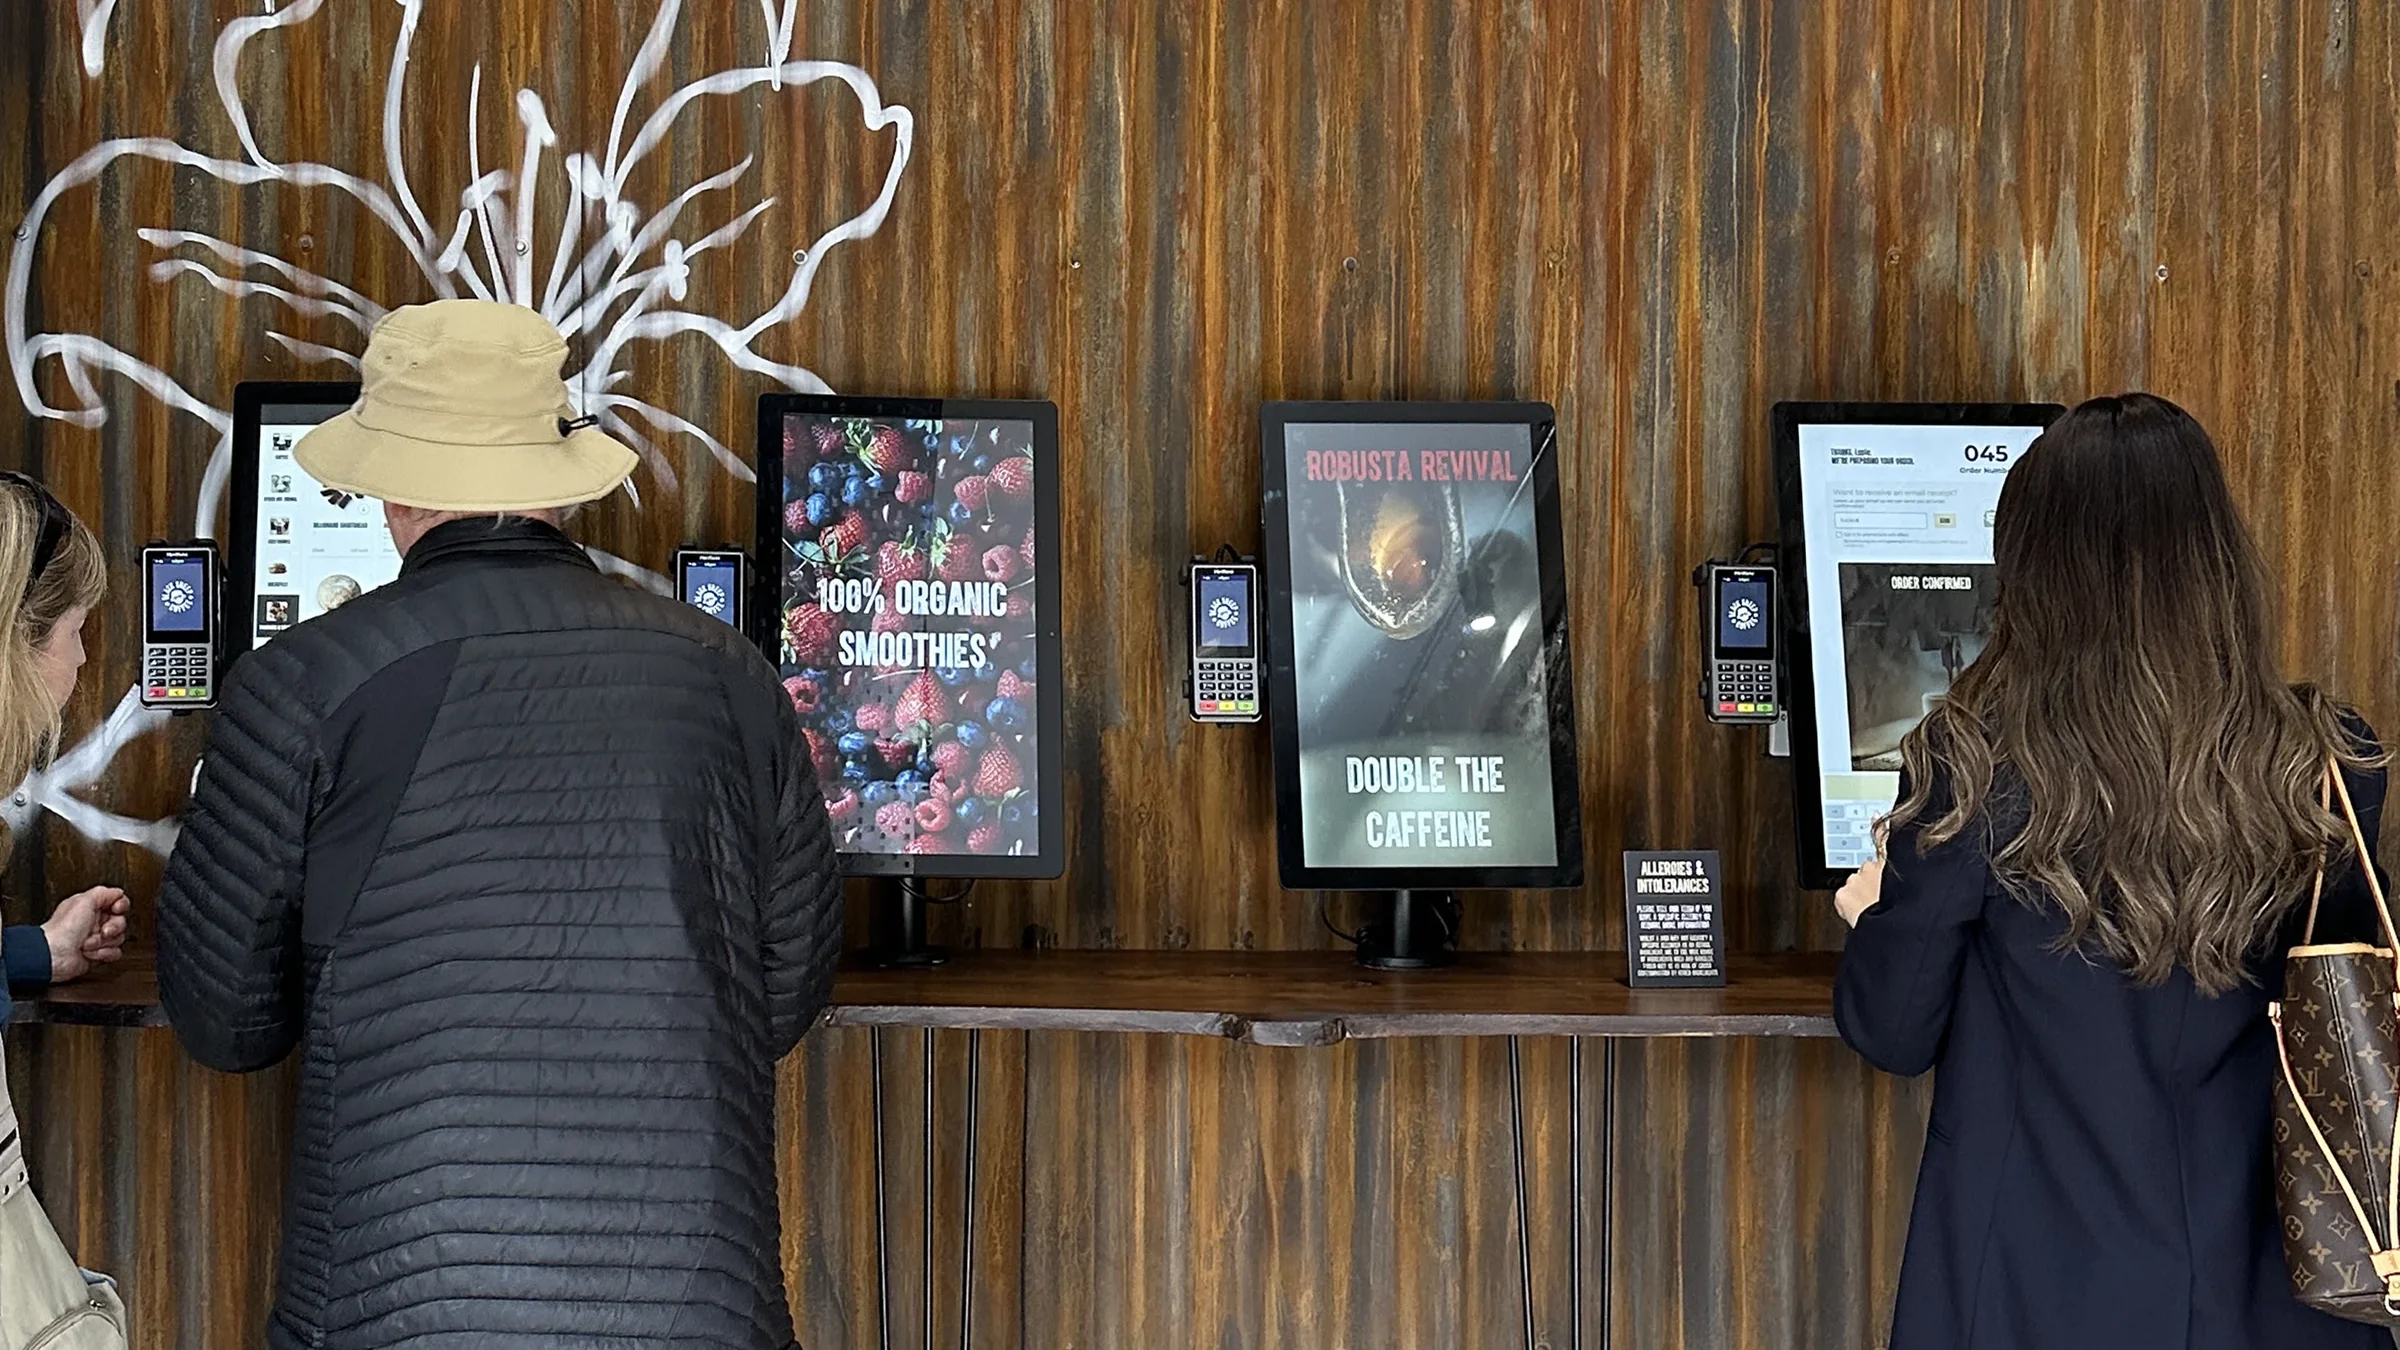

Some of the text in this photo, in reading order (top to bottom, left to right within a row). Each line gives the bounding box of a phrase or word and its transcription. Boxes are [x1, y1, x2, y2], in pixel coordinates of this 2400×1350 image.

[1306, 450, 1517, 481] ROBUSTA REVIVAL
[1964, 445, 2008, 462] 045
[1905, 489, 1926, 497] email
[1891, 575, 1971, 590] ORDER CONFIRMED
[817, 577, 1007, 617] 100% ORGANIC
[838, 630, 987, 668] SMOOTHIES
[1346, 756, 1505, 794] DOUBLE THE
[1366, 810, 1492, 848] CAFFEINE
[1641, 860, 1705, 876] ALLERGIES &
[1637, 877, 1709, 893] INTOLERANCES
